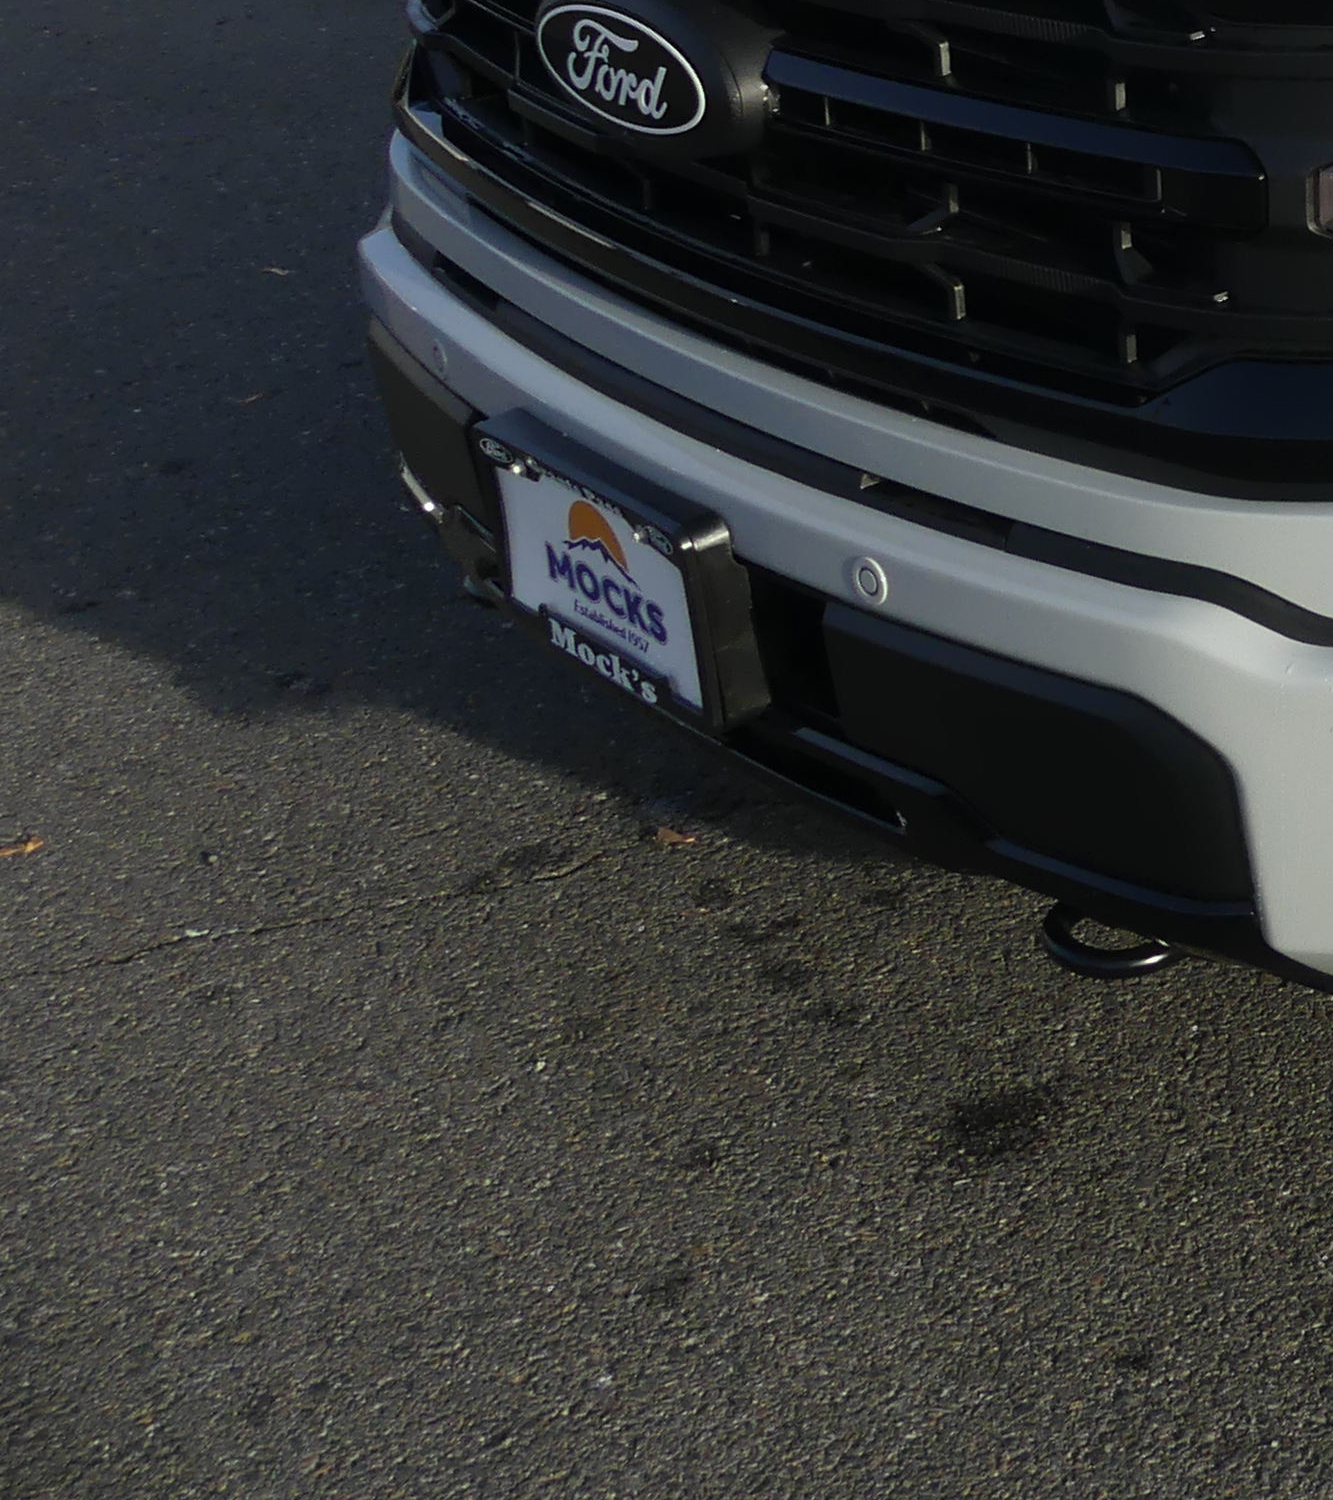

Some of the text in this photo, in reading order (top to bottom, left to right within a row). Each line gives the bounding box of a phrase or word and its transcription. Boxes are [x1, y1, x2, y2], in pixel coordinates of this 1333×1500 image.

[567, 19, 668, 120] Ford
[545, 540, 668, 645] MOCKS
[574, 599, 650, 653] Established 1957
[549, 618, 658, 703] Mock's
